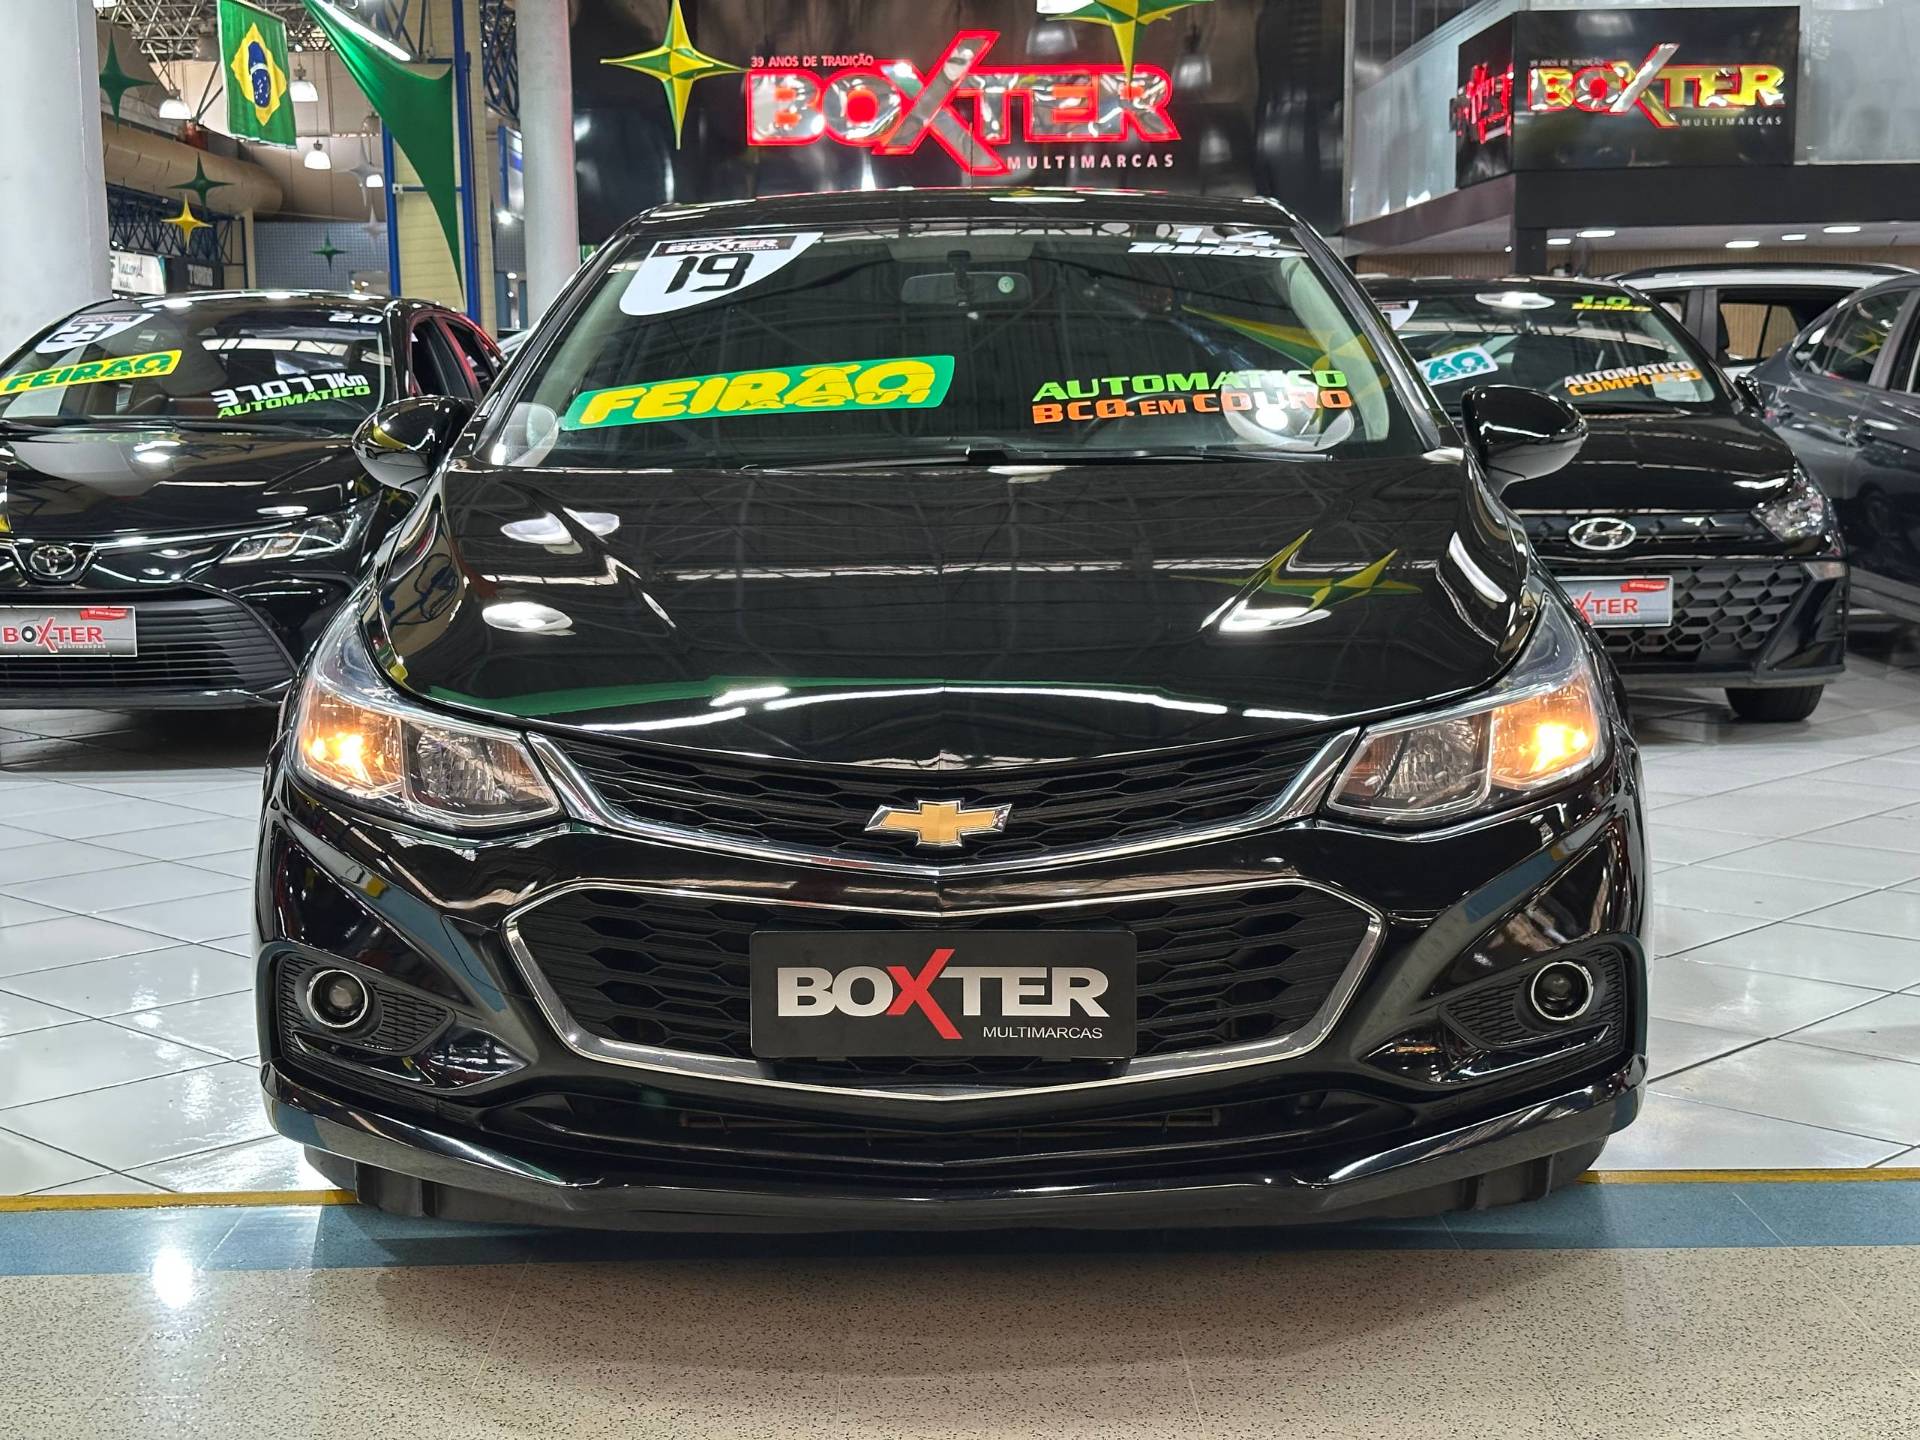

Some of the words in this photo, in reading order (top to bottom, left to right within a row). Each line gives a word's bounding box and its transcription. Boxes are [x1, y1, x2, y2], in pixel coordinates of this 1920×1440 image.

[751, 55, 765, 68] 39
[768, 56, 799, 68] ANOS
[803, 56, 818, 67] DE
[821, 53, 874, 68] TRADIÇÃO
[1529, 43, 1785, 129] BOXTER
[746, 30, 1182, 176] BOXTER
[1681, 116, 1783, 128] MULTIMARCAS
[1007, 153, 1174, 169] MULTIMARCAS
[665, 237, 778, 254] BOXTER
[1177, 227, 1281, 247] 1.4
[664, 252, 755, 294] 19
[1581, 295, 1631, 305] 1.0
[328, 312, 384, 324] 2.0
[47, 323, 114, 343] 23
[4, 354, 173, 391] FEIRÃO
[1564, 361, 1695, 387] AUTOMATICO
[218, 385, 371, 418] AUTOMATICO
[578, 361, 936, 424] FEIRÃO
[1140, 399, 1187, 416] EM
[1193, 389, 1352, 413] COURO
[1574, 591, 1638, 625] XTER
[2, 617, 105, 653] BOXTER
[777, 949, 1111, 1040] BOXTER
[983, 1026, 1103, 1040] MULTIMARCAS
